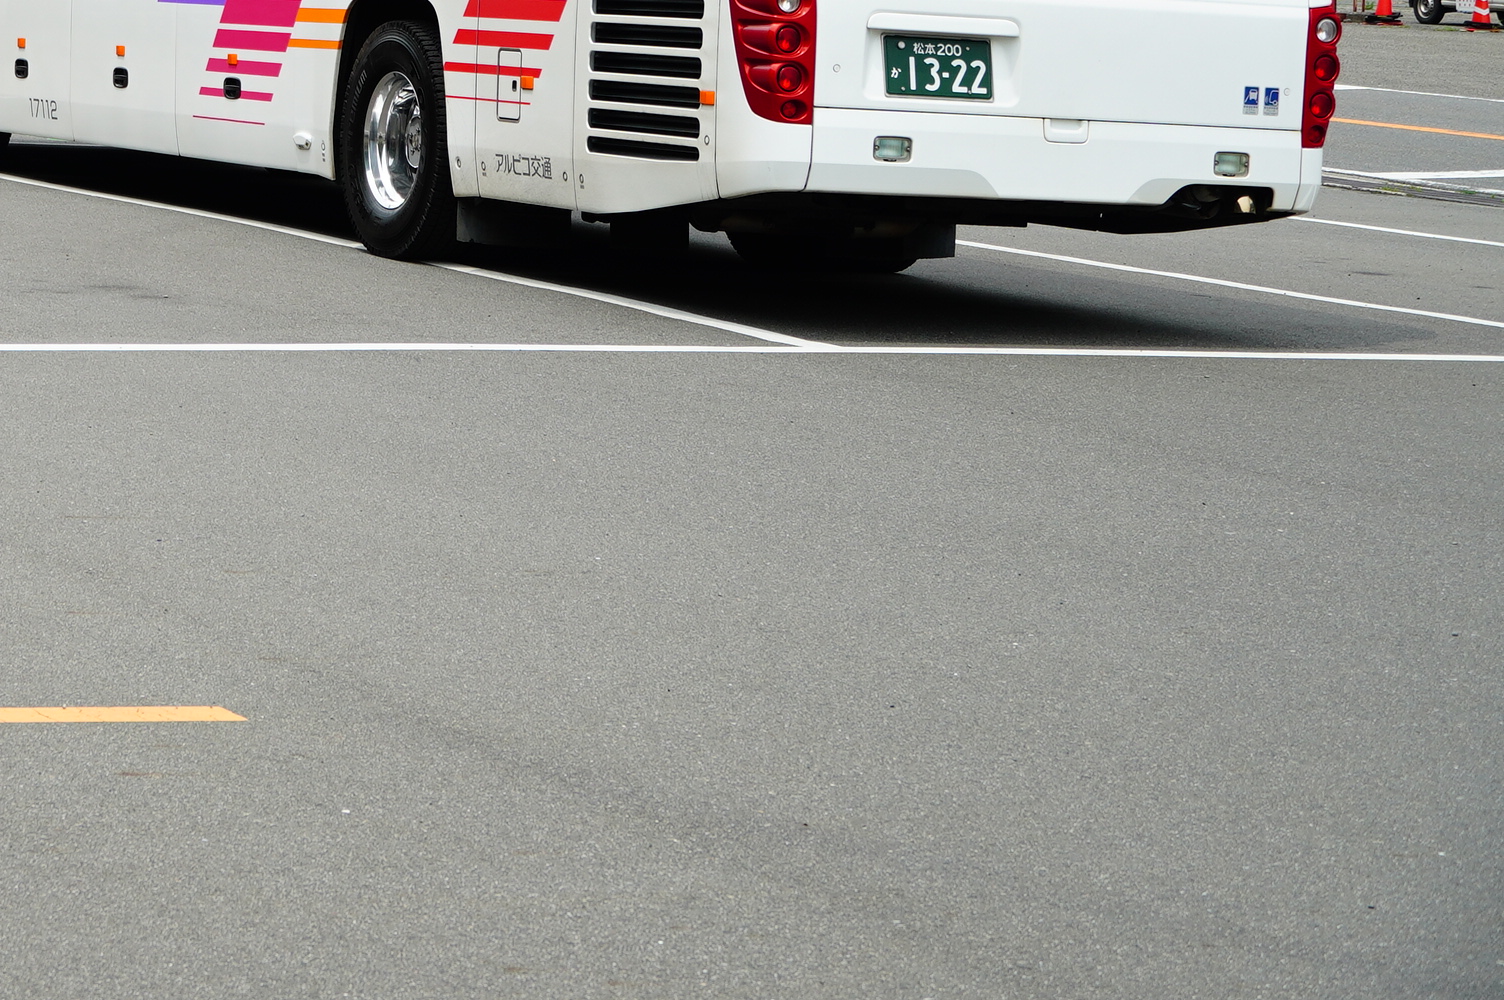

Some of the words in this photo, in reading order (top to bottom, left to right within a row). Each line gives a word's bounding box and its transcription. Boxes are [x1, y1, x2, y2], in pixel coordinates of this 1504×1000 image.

[890, 67, 902, 79] か
[909, 56, 988, 94] 13-22
[28, 97, 58, 120] 17112
[494, 153, 553, 180] アルピコ交通
